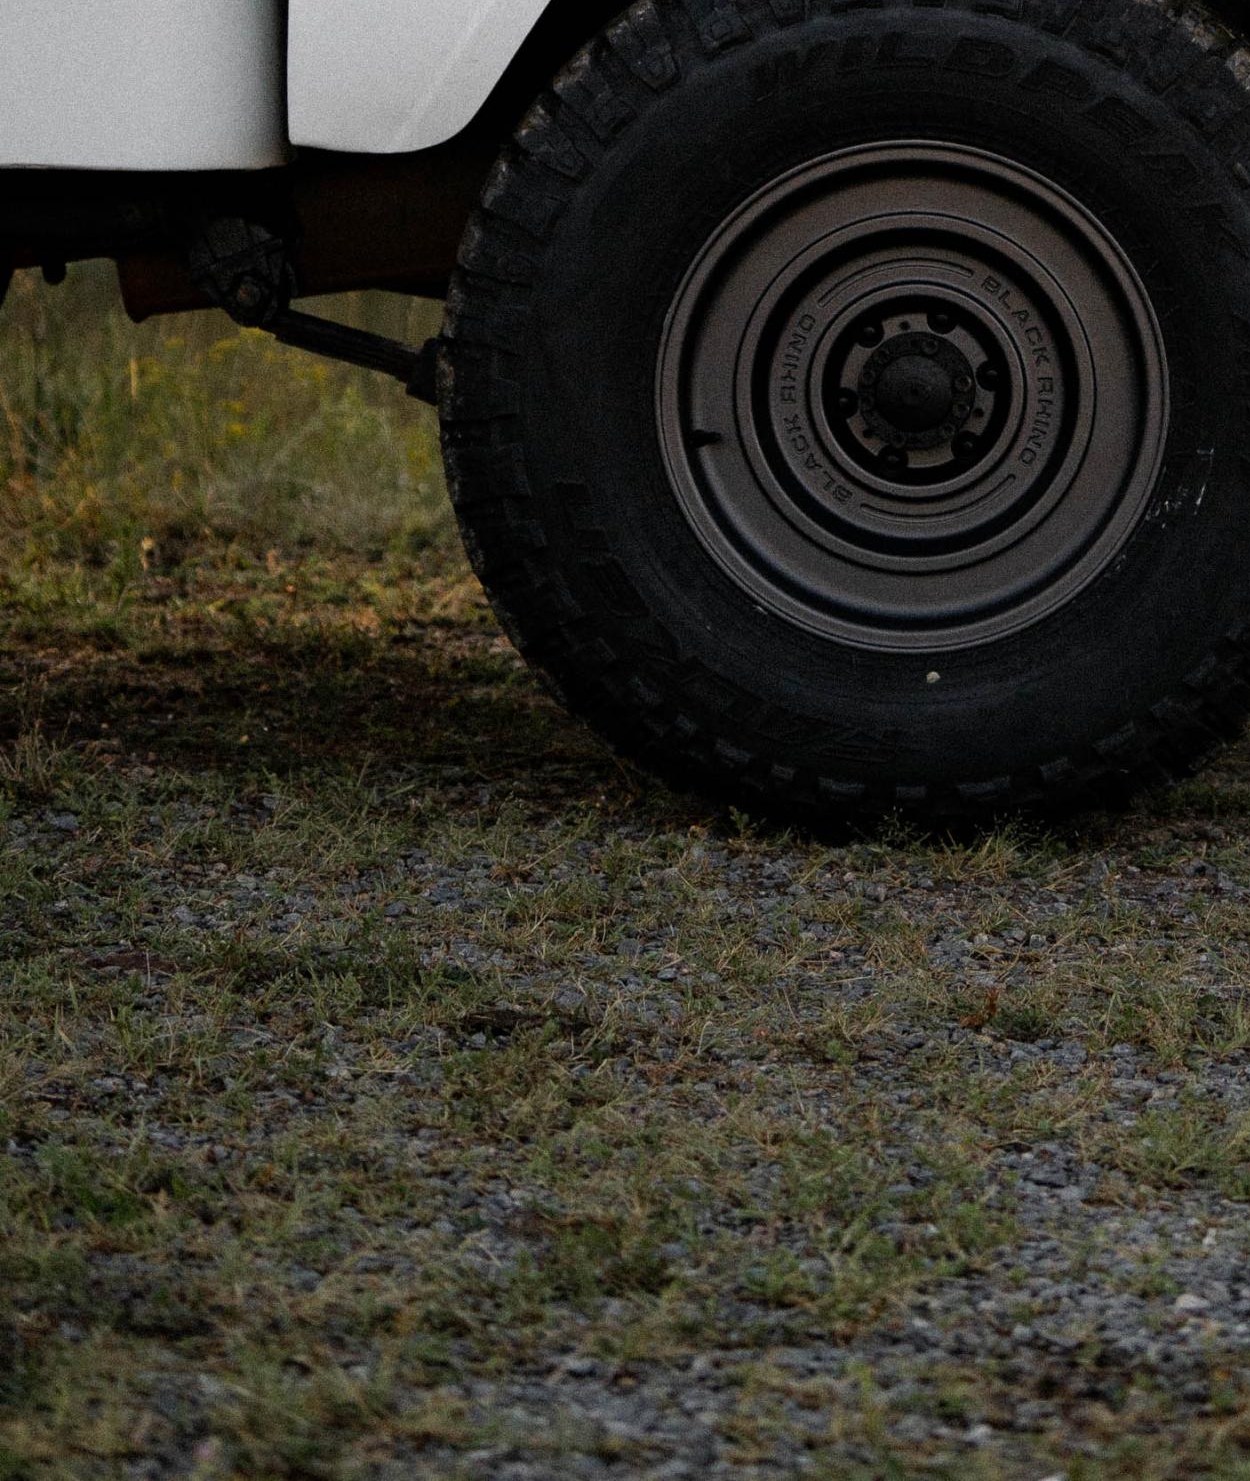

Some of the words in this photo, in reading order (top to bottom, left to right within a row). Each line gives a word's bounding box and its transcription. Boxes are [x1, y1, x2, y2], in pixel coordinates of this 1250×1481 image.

[780, 313, 817, 405] RHINO
[981, 275, 1050, 367] BLACK
[1020, 376, 1054, 466] RHINO
[783, 413, 853, 504] BLACK
